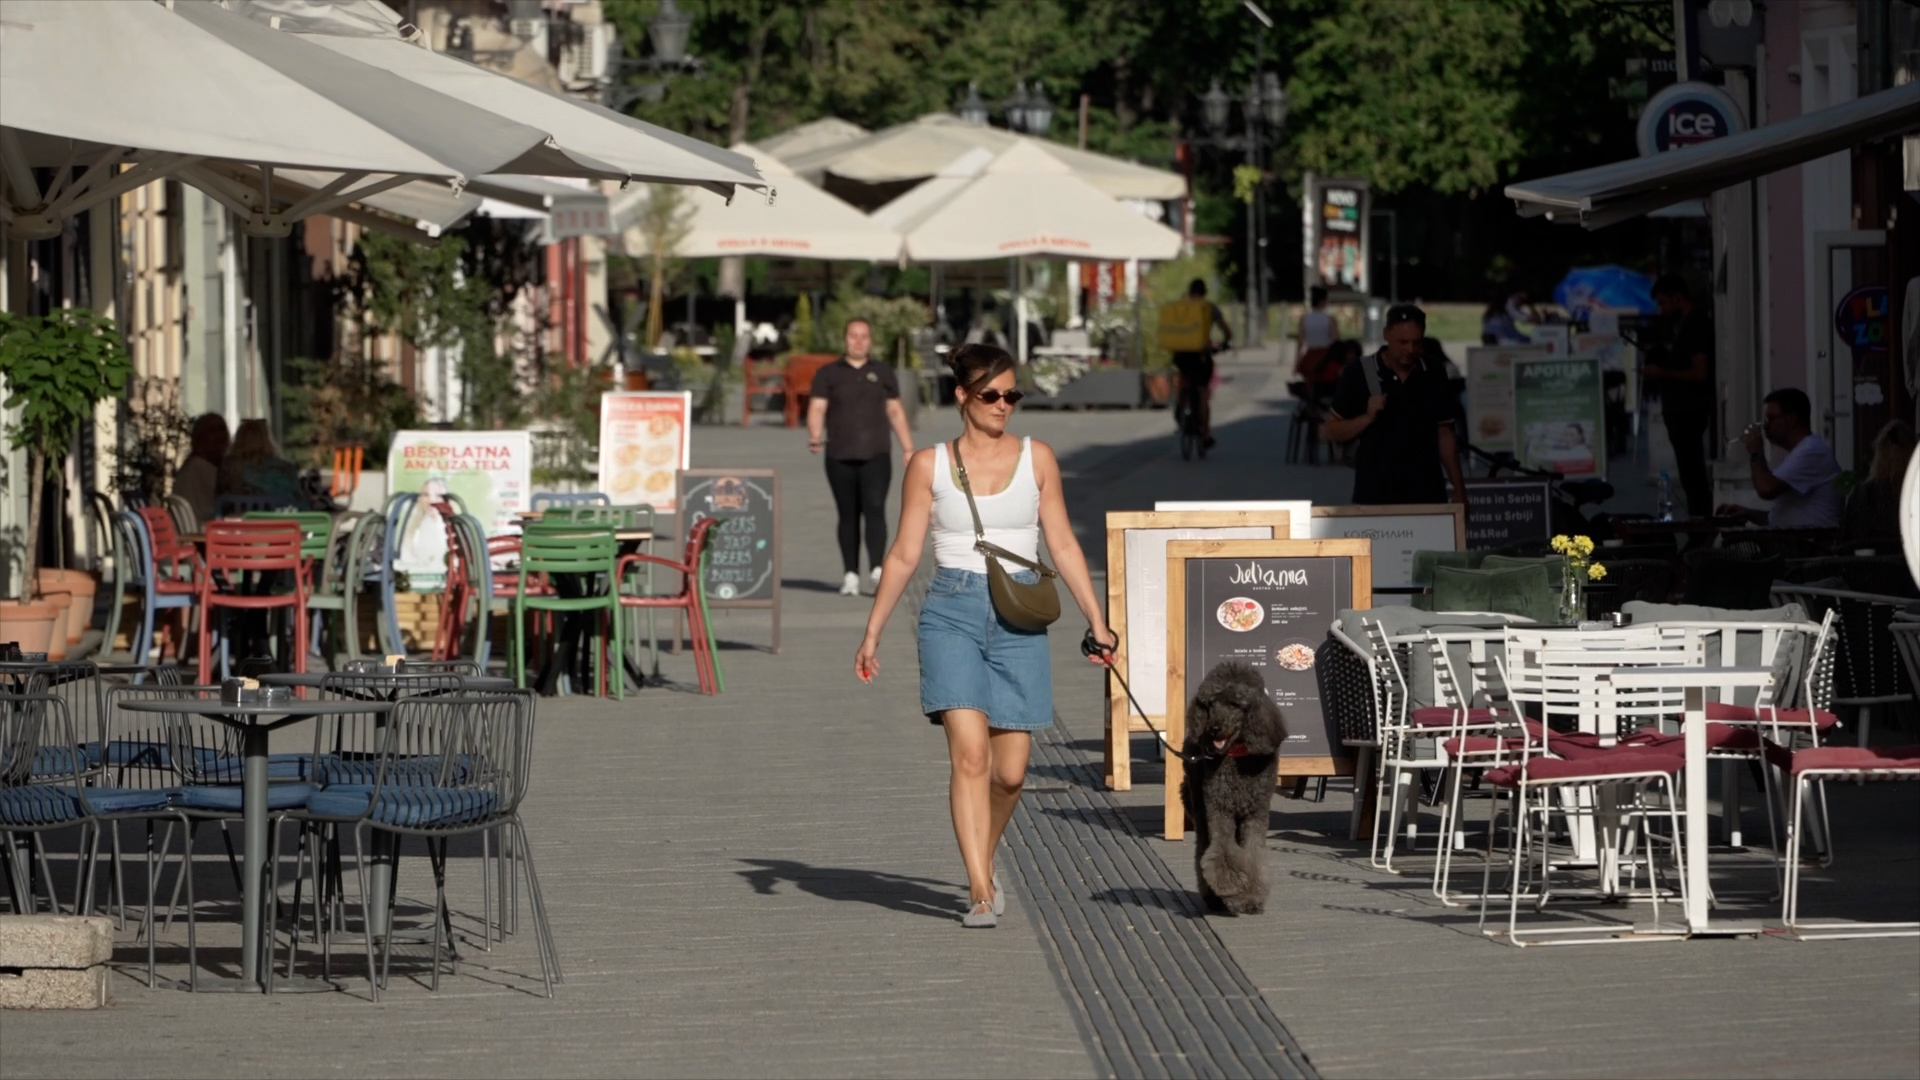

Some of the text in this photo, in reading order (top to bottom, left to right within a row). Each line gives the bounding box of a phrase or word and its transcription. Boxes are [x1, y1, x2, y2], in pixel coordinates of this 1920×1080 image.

[403, 446, 512, 459] BESPLATNA
[404, 460, 511, 471] ANALIZA TELA
[1468, 493, 1542, 505] ines in Serbia
[1469, 510, 1534, 523] vina u Srbiji
[1466, 528, 1509, 539] ite&Red
